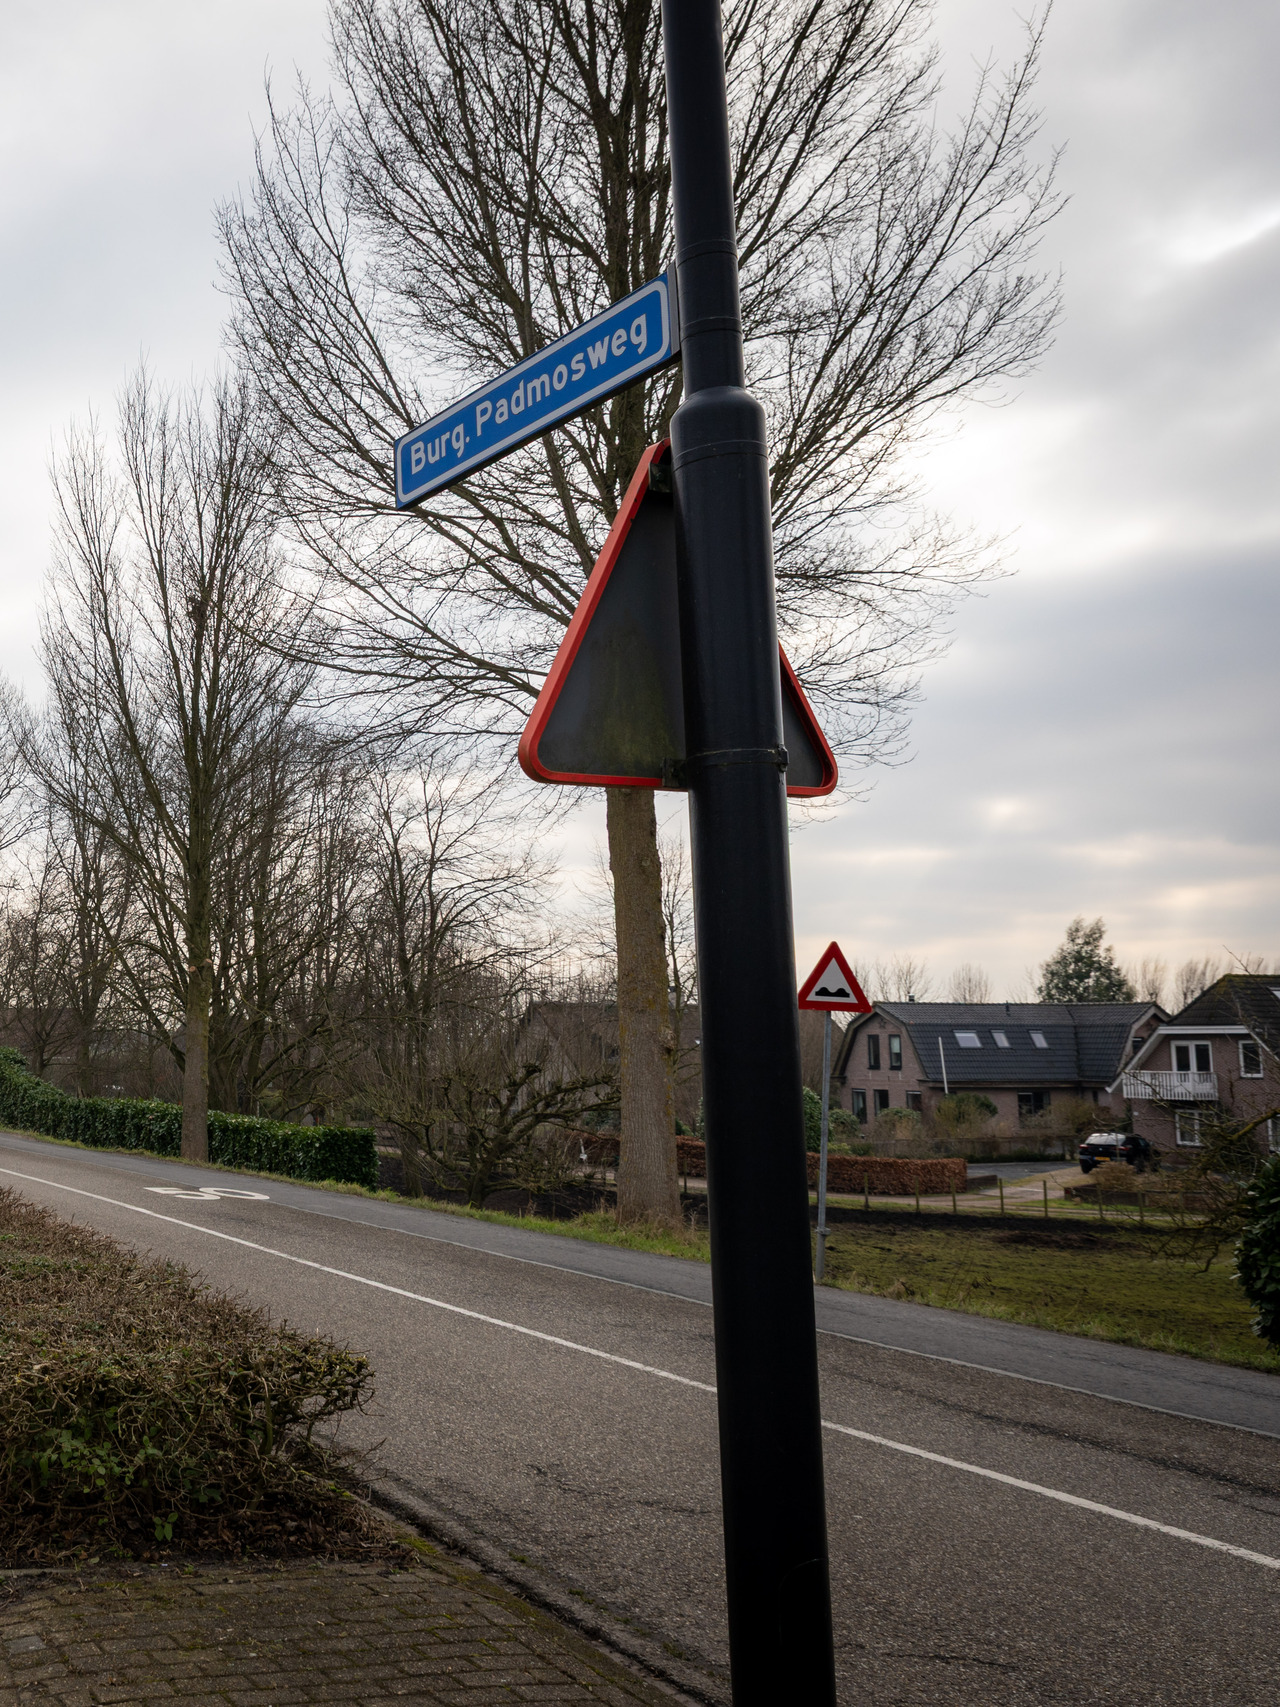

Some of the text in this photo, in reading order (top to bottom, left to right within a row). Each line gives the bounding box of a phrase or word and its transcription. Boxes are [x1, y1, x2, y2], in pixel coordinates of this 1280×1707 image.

[410, 314, 648, 475] Burg. Padmosweg
[143, 1187, 270, 1200] 50
